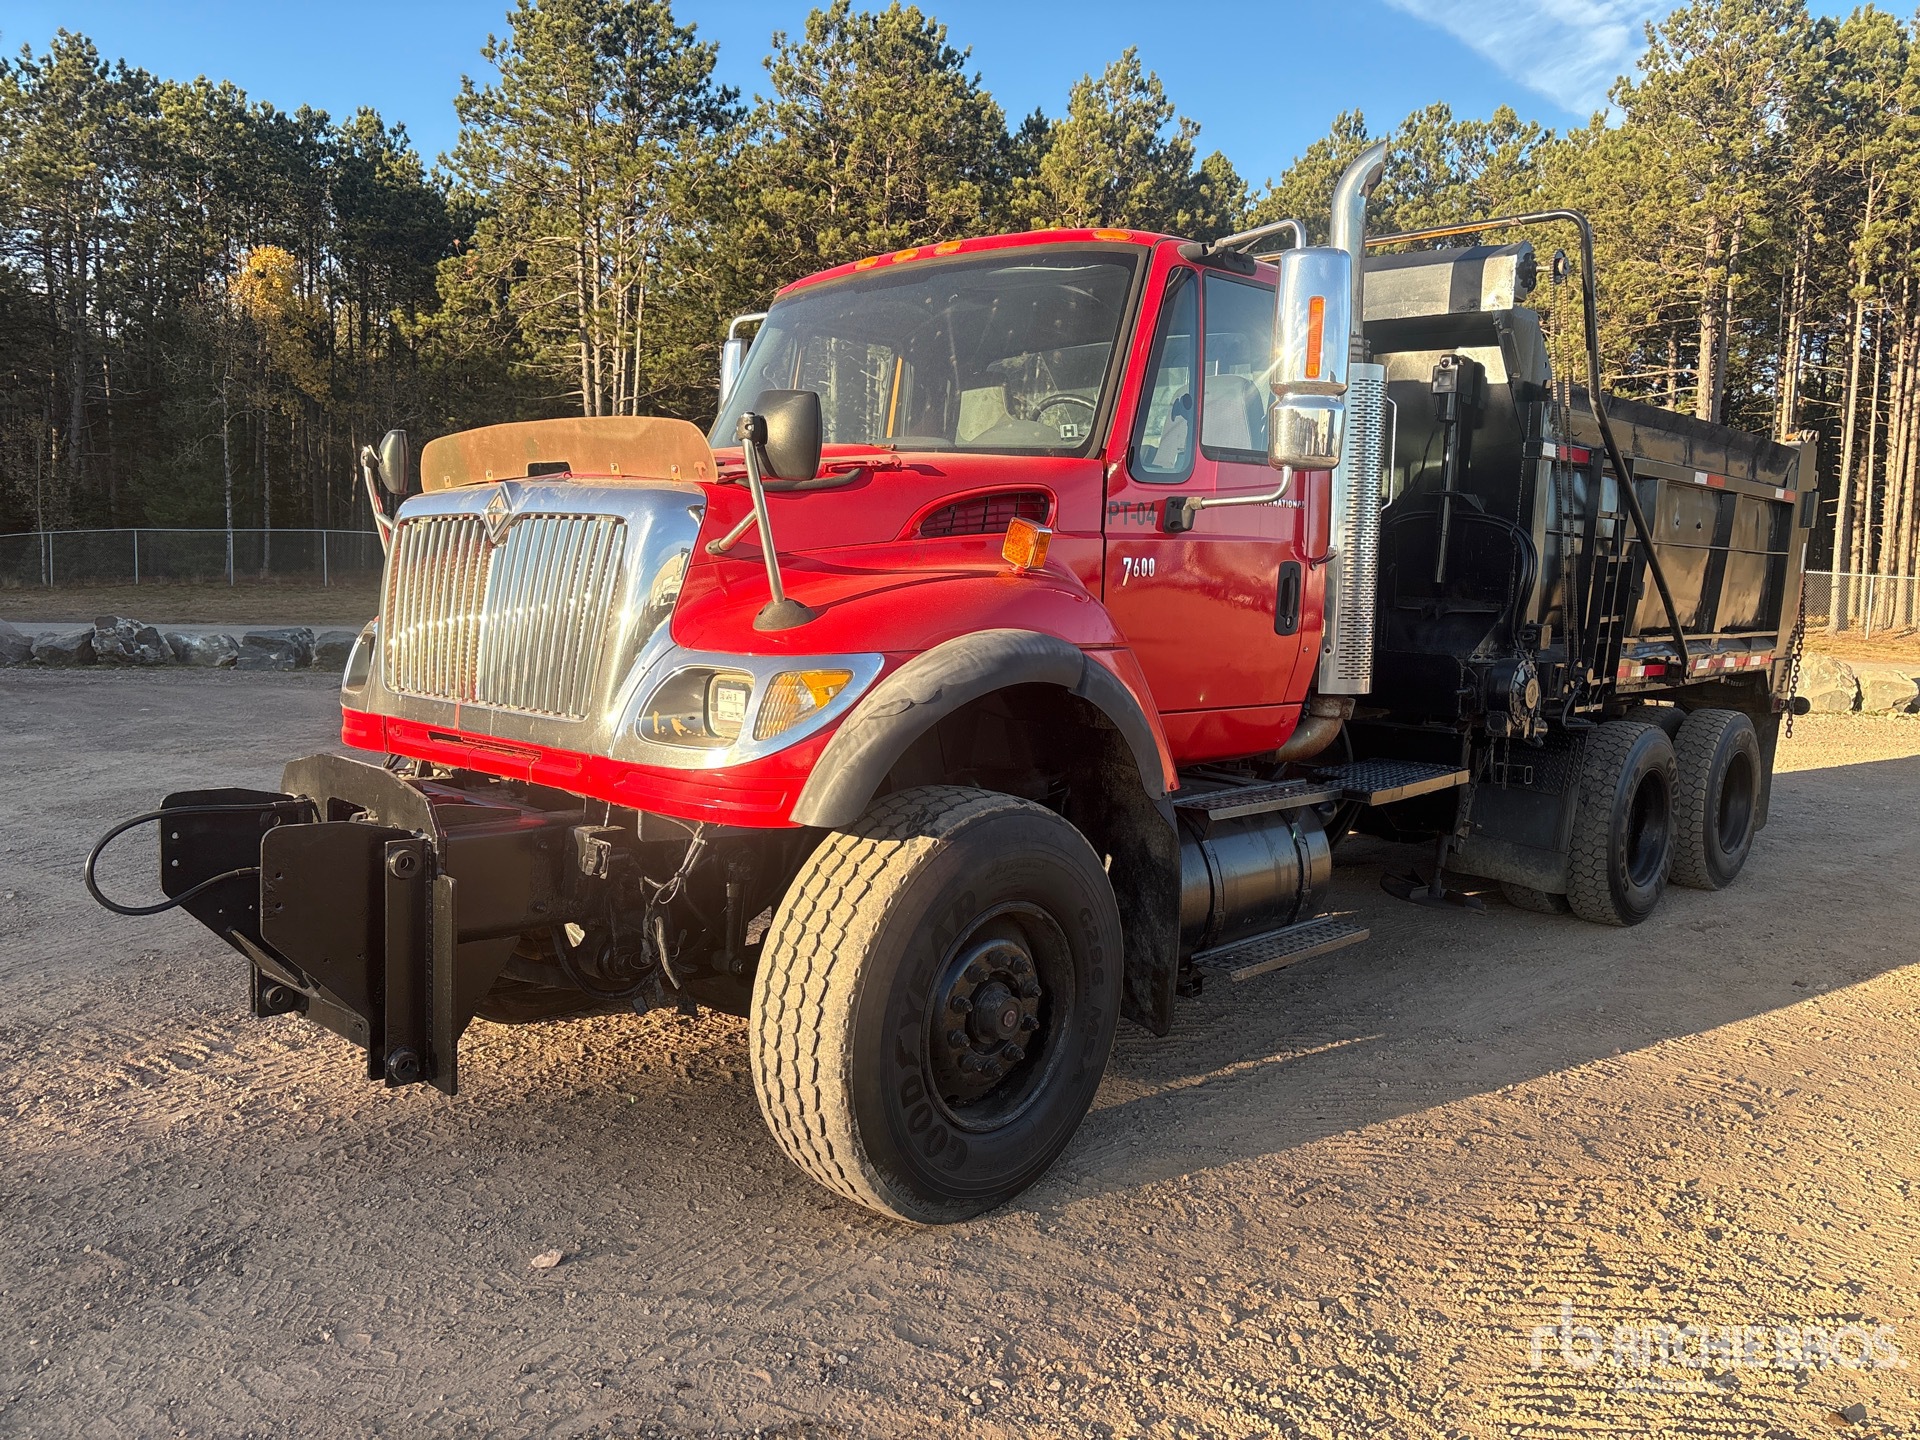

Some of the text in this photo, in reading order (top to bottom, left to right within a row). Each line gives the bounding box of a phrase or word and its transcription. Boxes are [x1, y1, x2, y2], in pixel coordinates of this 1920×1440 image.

[1107, 501, 1156, 525] PT-04
[1122, 557, 1155, 586] 7600
[895, 889, 977, 1173] GOODYEAR
